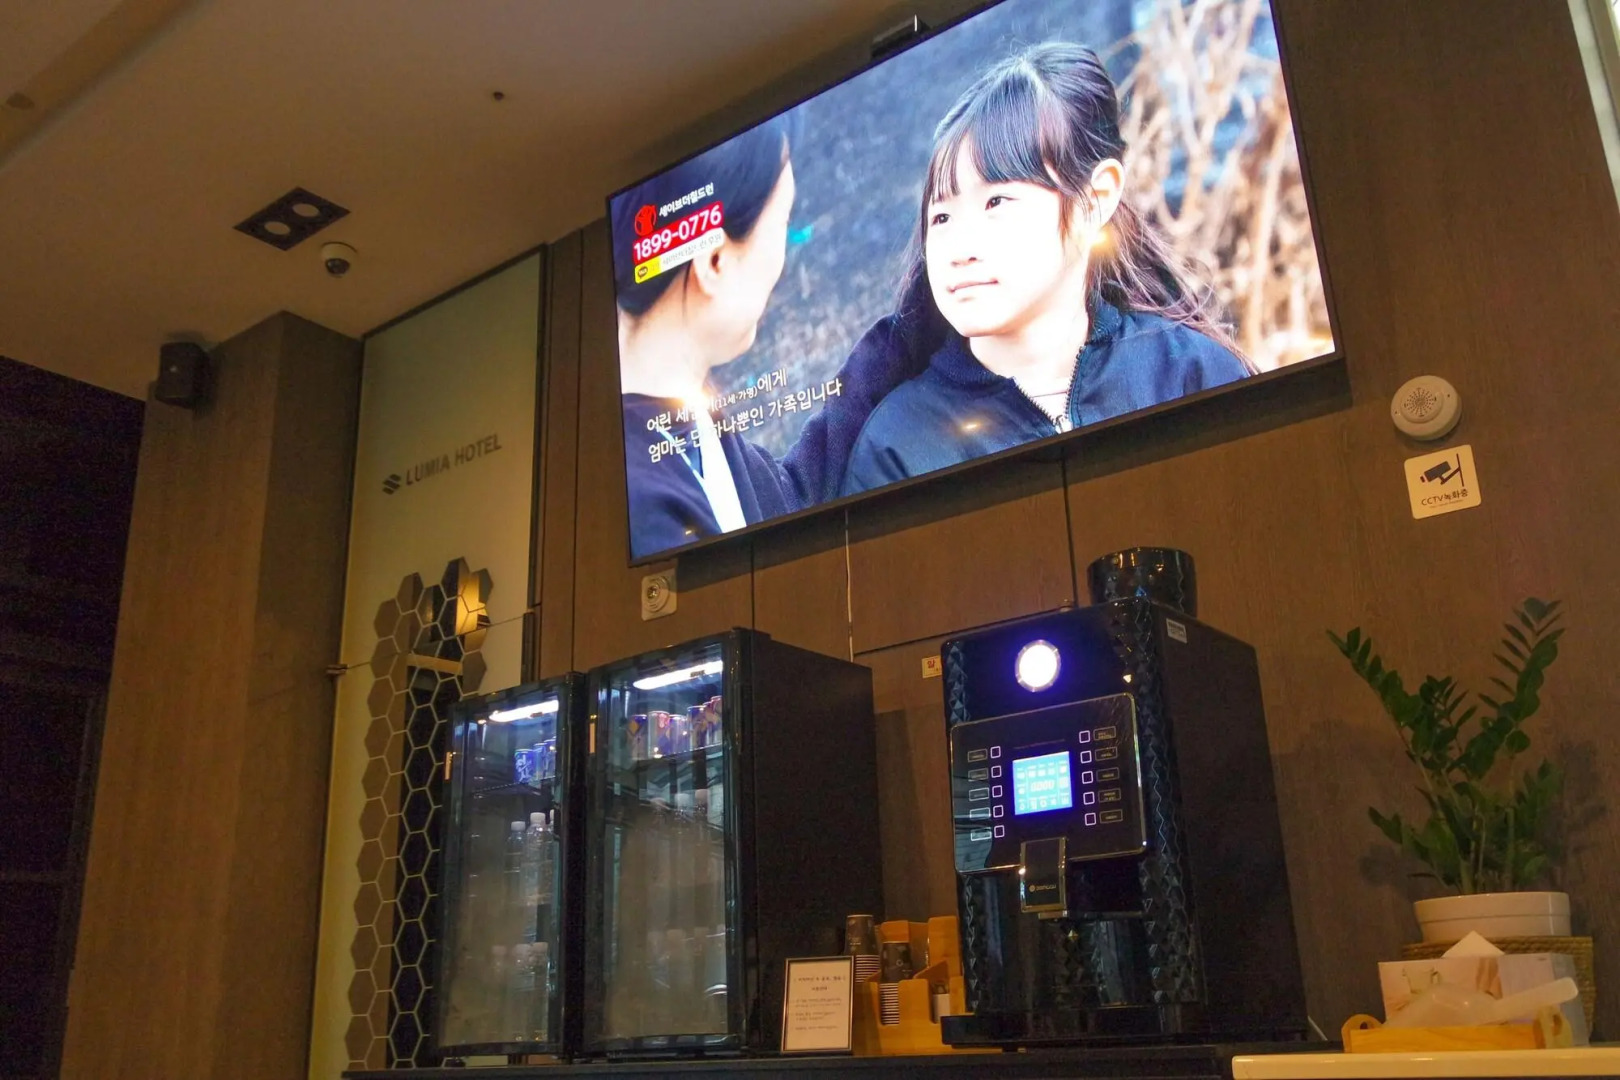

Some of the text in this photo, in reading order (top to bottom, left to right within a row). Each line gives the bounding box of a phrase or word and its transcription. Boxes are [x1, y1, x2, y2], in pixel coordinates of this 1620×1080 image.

[634, 204, 721, 260] 1899-0776
[646, 411, 672, 432] 어린
[648, 437, 687, 463] 엄마는
[768, 378, 842, 418] 가족입니다
[406, 433, 503, 486] LUMIA HOTEL
